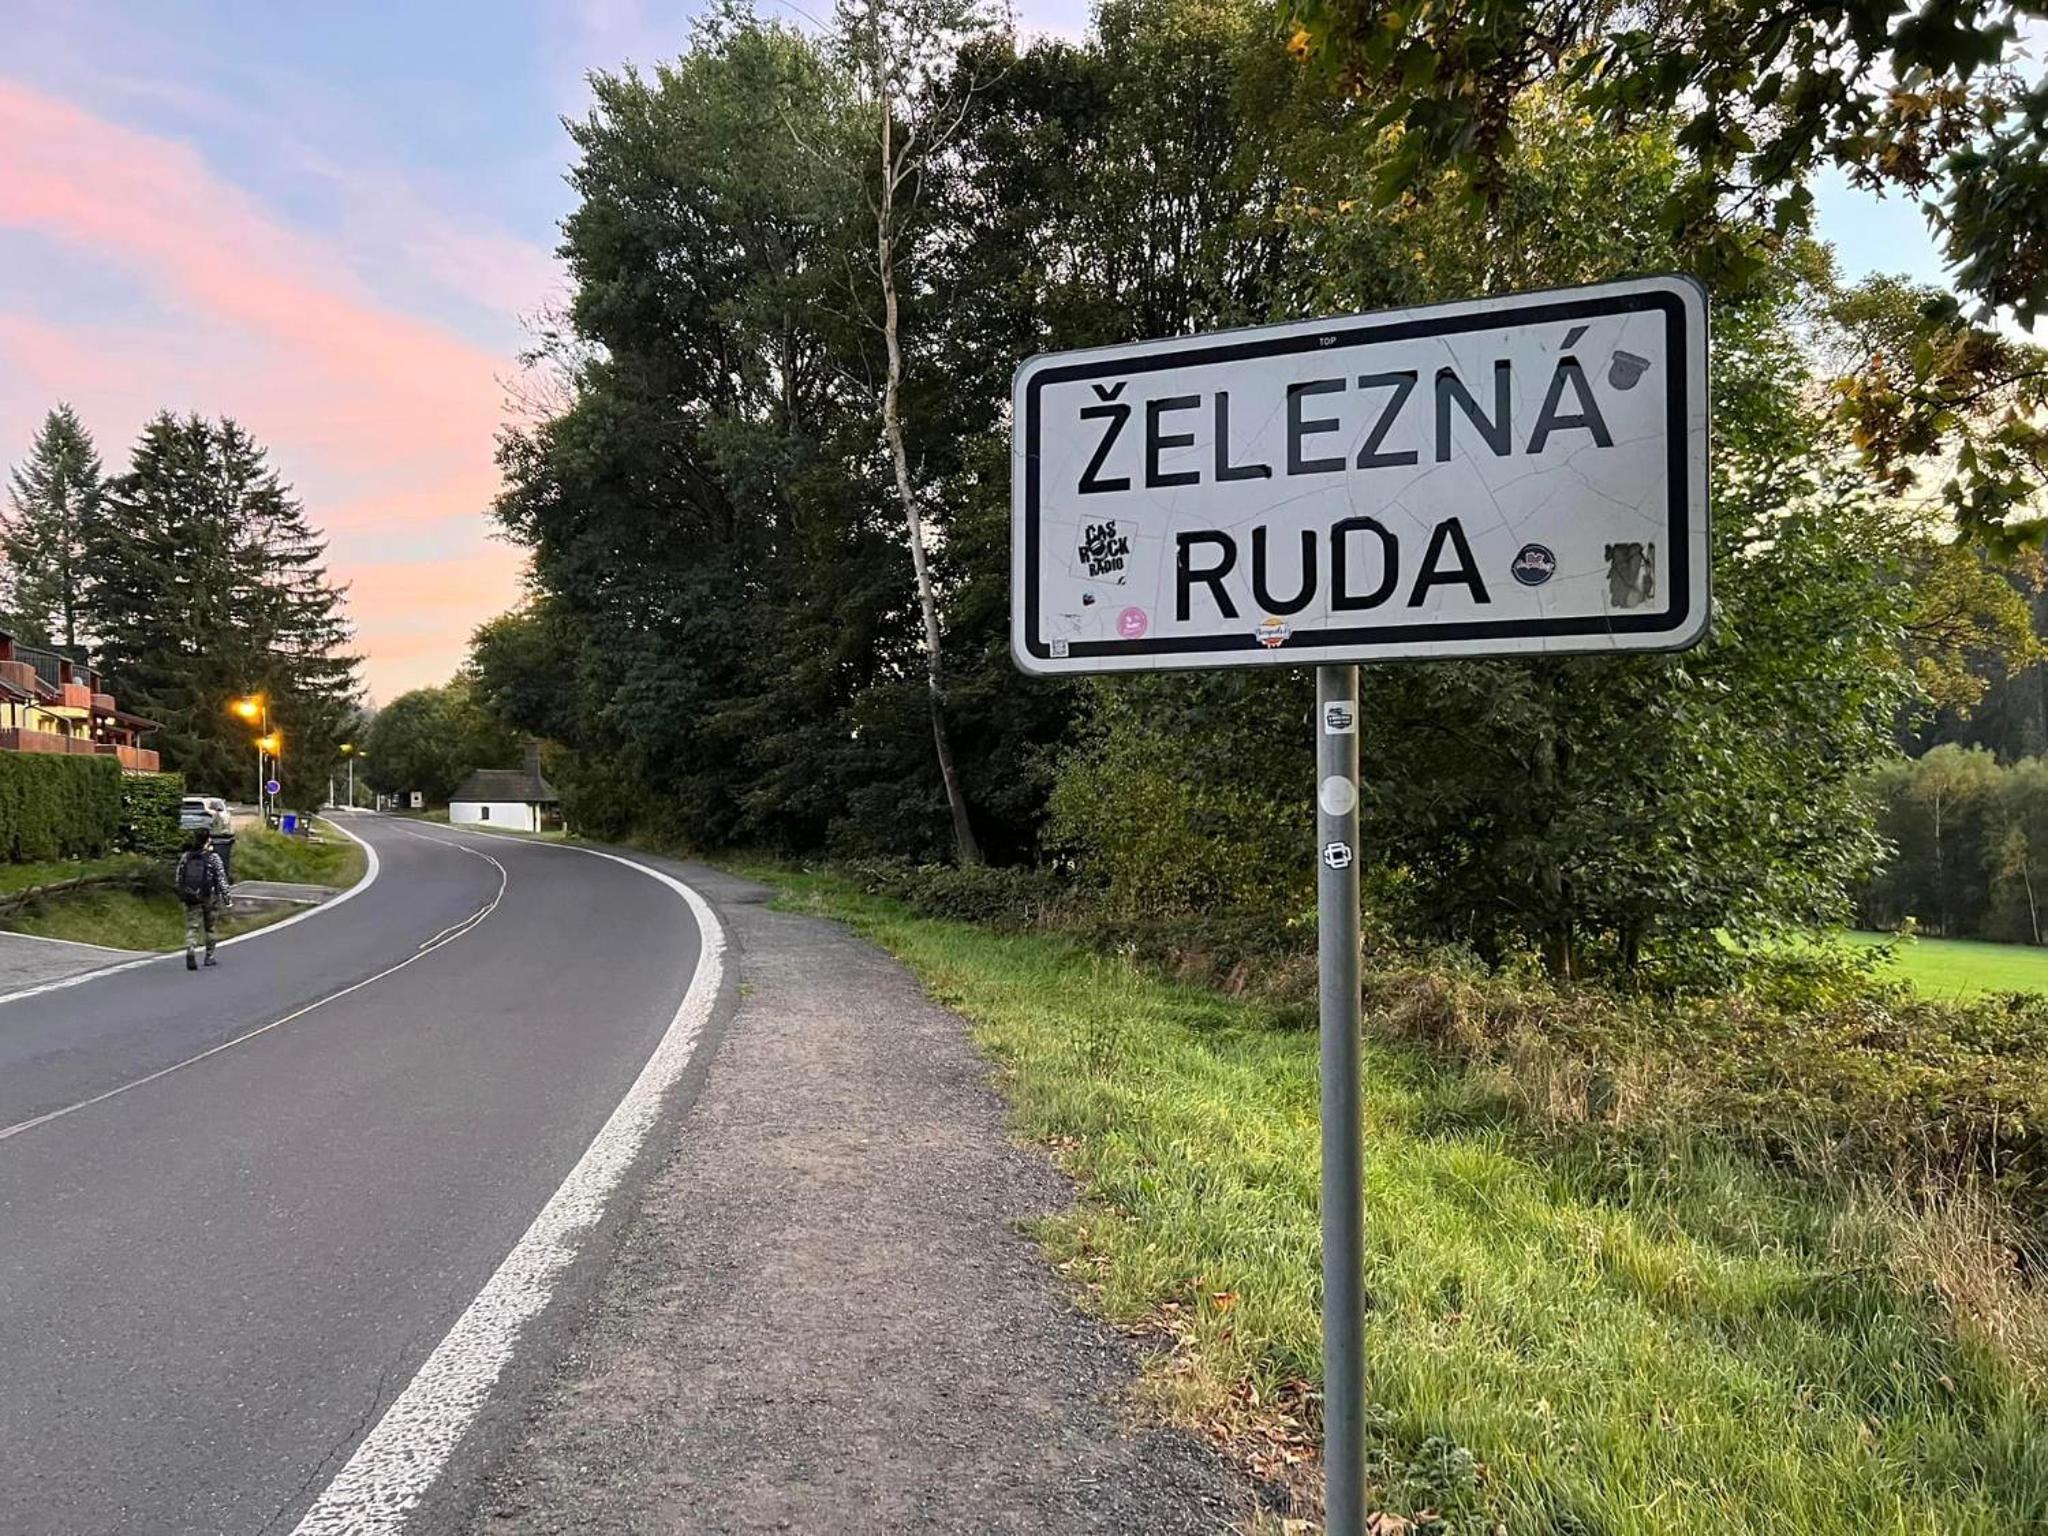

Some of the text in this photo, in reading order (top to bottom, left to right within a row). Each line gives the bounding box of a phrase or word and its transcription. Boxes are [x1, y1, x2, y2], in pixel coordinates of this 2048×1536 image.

[1320, 336, 1337, 346] TOP
[1078, 325, 1615, 495] ŽELEZNÁ
[1078, 536, 1129, 563] ROCK
[1176, 515, 1492, 622] RUDA
